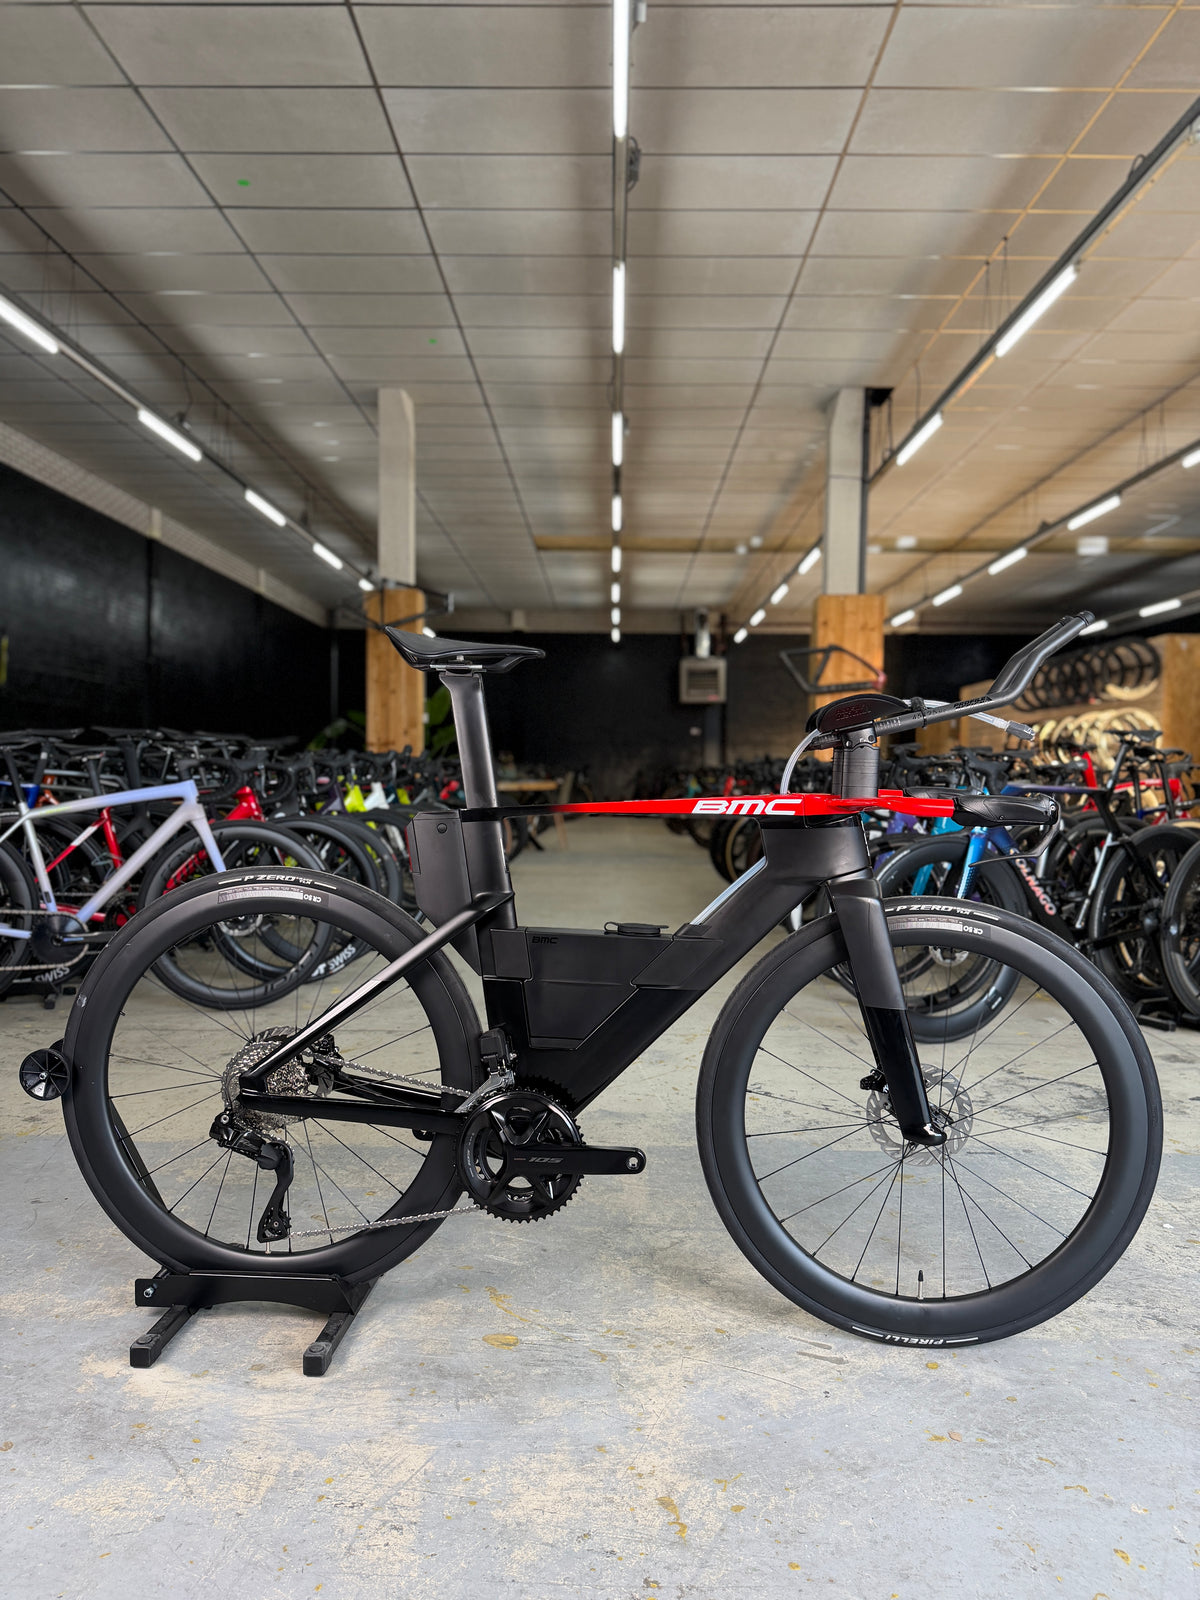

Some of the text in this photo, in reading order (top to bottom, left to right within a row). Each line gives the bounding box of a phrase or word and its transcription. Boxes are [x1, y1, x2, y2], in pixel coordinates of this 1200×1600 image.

[691, 799, 803, 815] BMC
[256, 874, 296, 882] ZERO
[908, 904, 953, 912] ZERO
[531, 935, 560, 944] BMC
[328, 943, 356, 970] SWISS
[884, 1334, 944, 1345] PIRELLI
